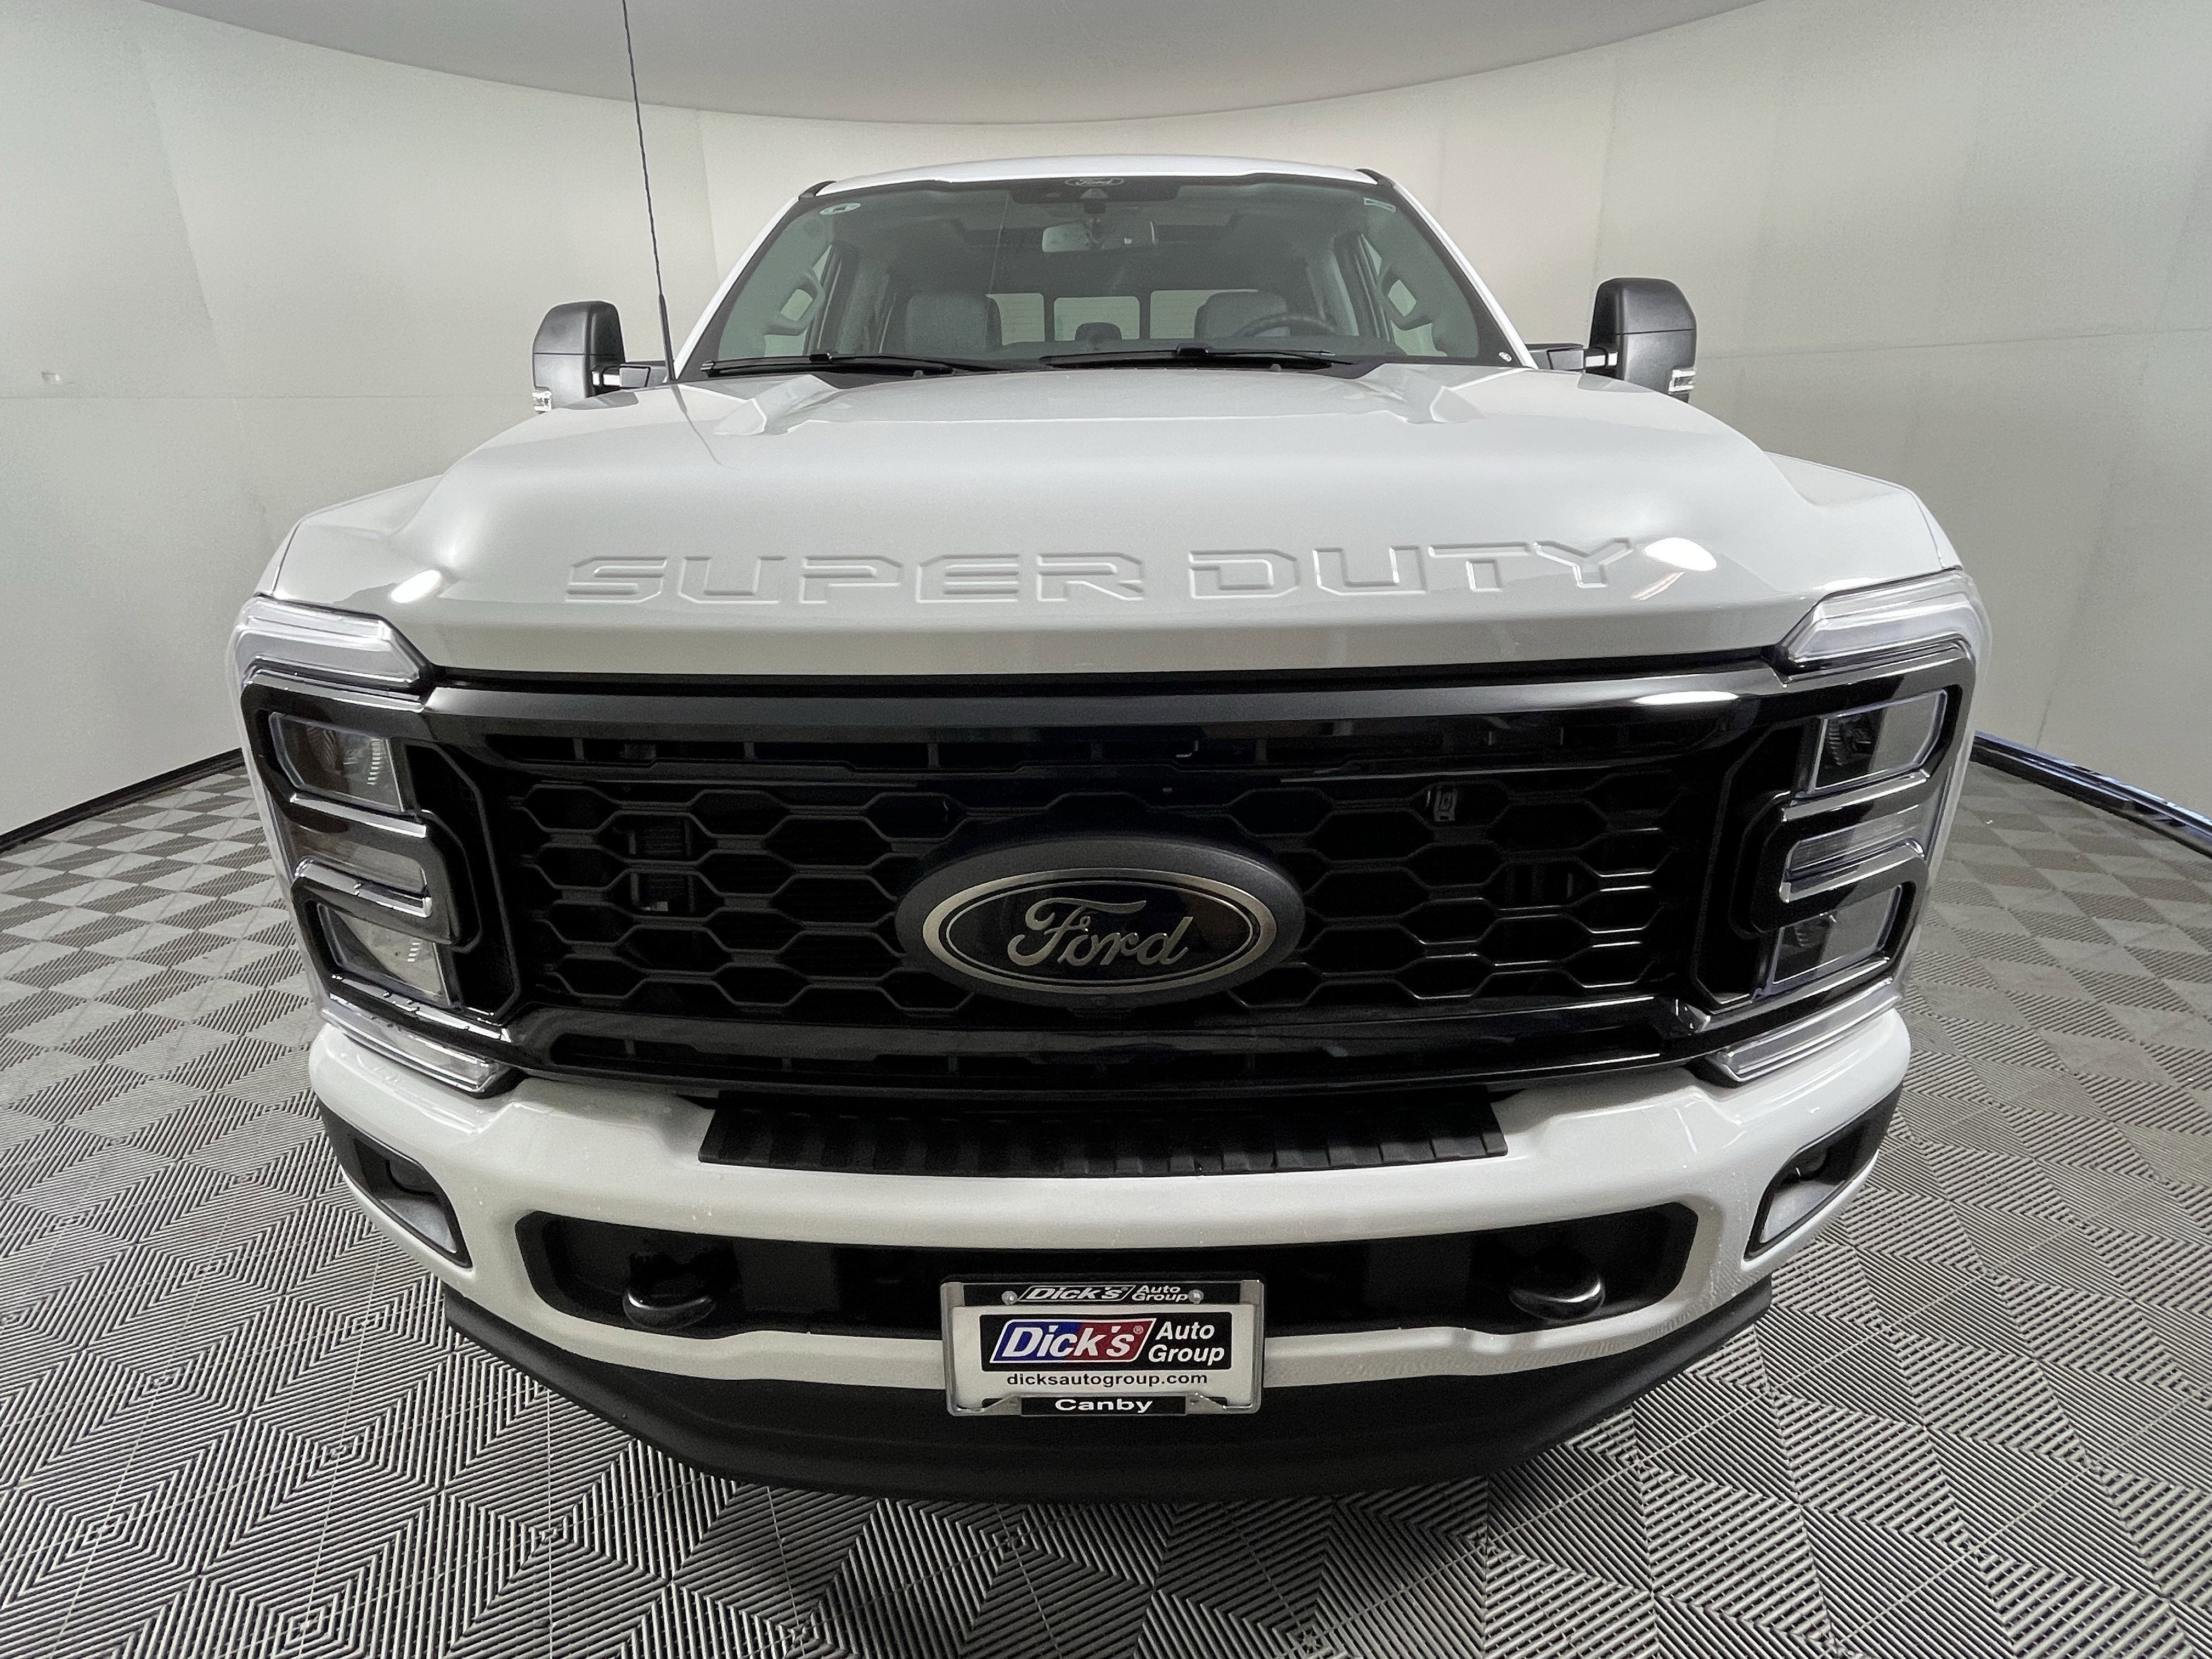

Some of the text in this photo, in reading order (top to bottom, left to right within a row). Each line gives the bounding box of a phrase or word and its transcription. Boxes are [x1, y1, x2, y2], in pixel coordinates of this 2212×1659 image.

[565, 537, 1635, 605] SUPER DUTY
[1007, 897, 1193, 966] Ford
[1026, 1286, 1122, 1300] Dick's
[1131, 1293, 1189, 1302] Group
[1136, 1285, 1181, 1293] Auto
[1155, 1321, 1215, 1340] Auto
[1002, 1325, 1135, 1358] Dick's
[1148, 1344, 1225, 1366] Group
[1007, 1373, 1207, 1387] dicksautogroup.com
[1054, 1398, 1153, 1413] Canby
